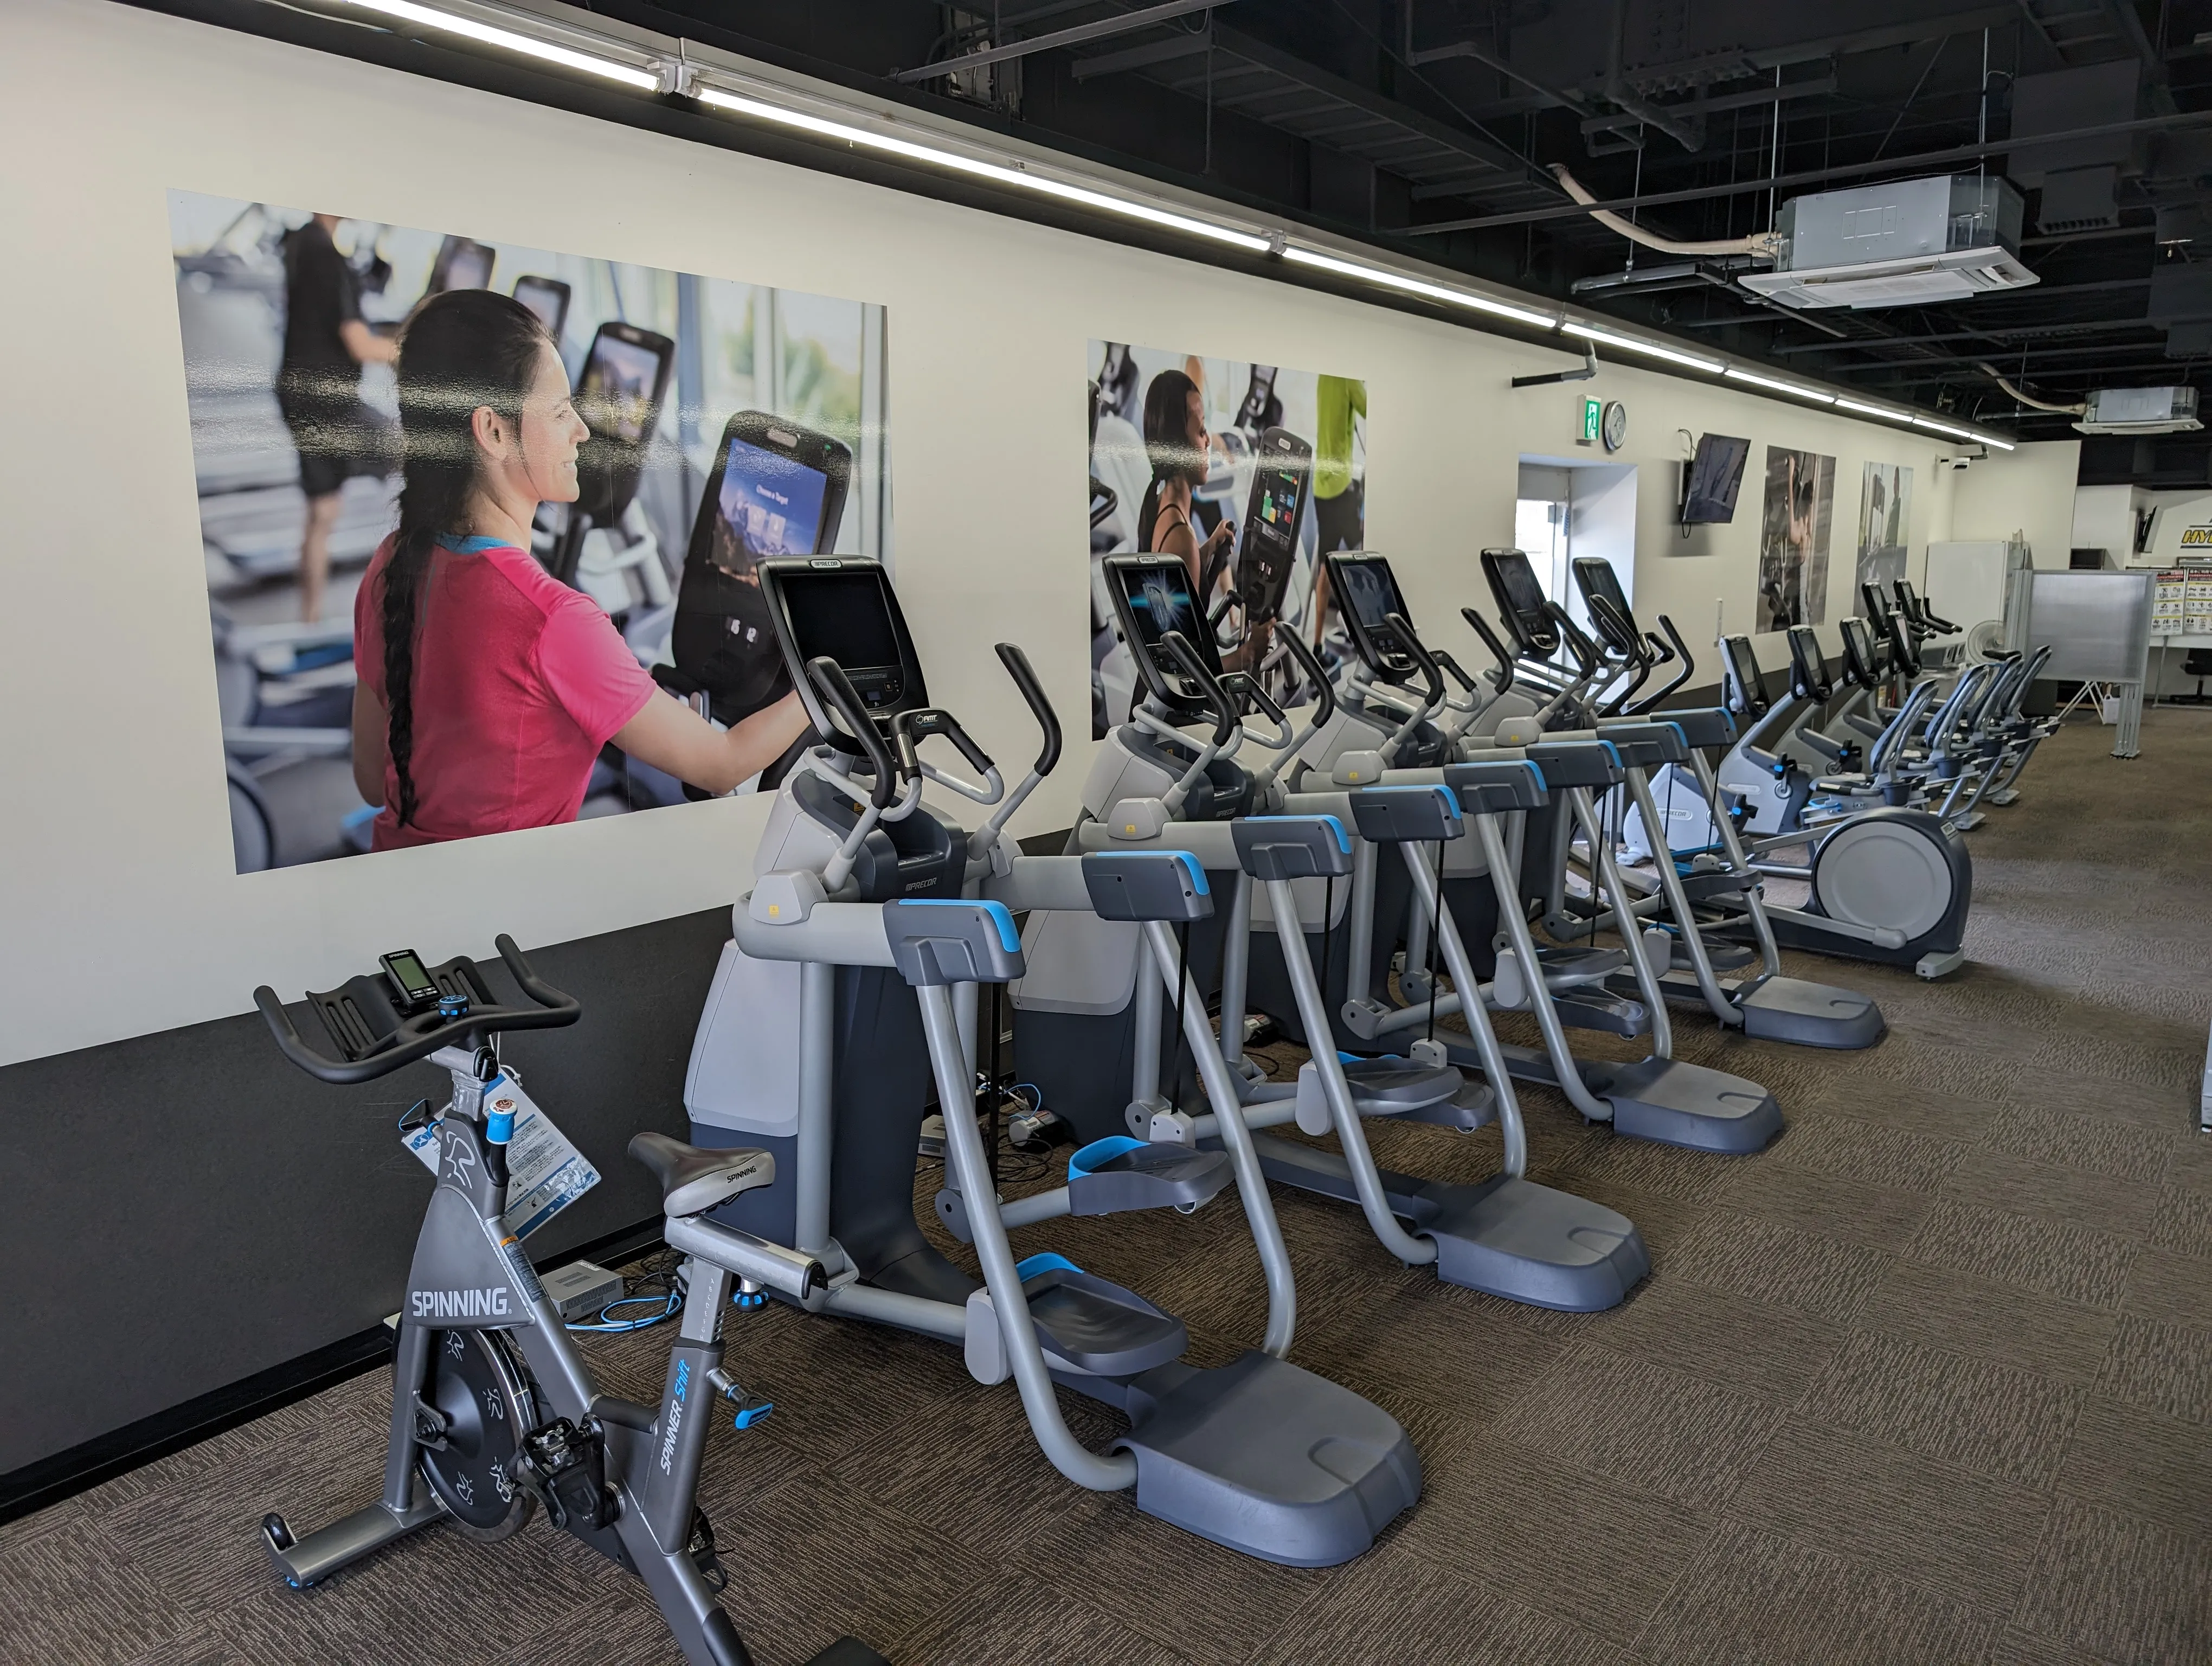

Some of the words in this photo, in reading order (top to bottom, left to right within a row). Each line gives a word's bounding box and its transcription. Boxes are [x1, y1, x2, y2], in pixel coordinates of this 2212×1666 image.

[907, 877, 937, 891] PRECOR
[726, 1165, 757, 1183] SPINNING
[411, 1287, 508, 1317] SPINNING
[660, 1399, 682, 1476] SPINNER
[674, 1359, 690, 1402] Shift
